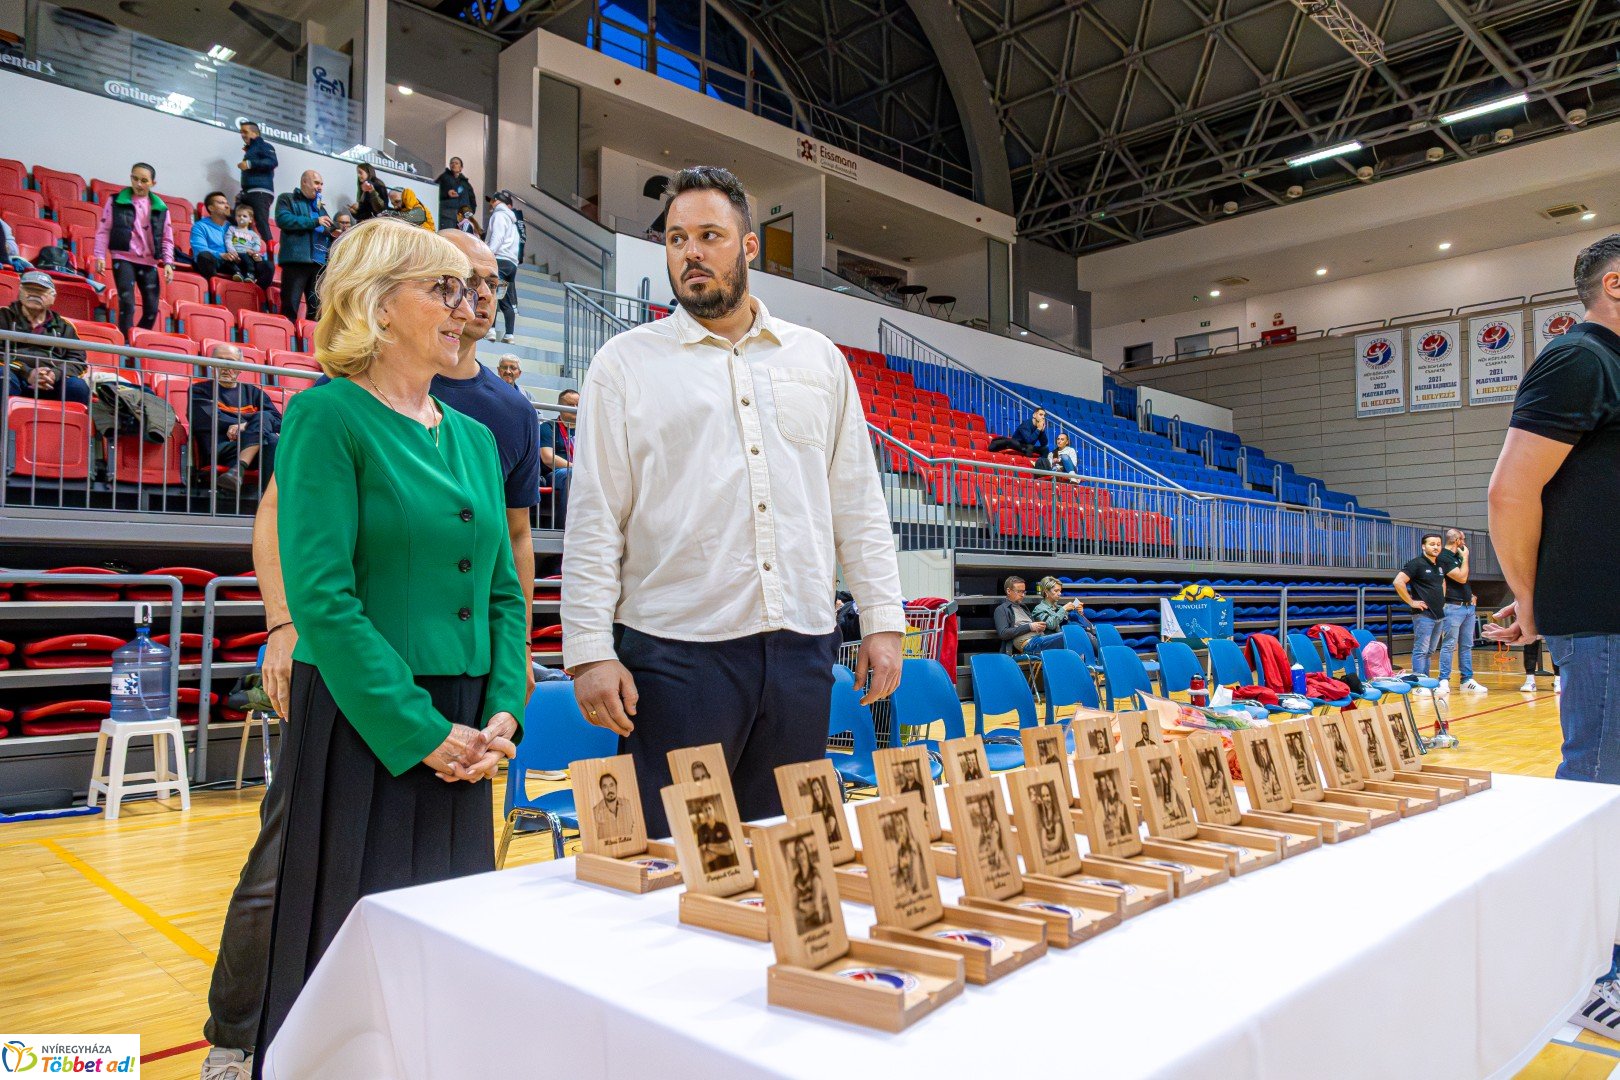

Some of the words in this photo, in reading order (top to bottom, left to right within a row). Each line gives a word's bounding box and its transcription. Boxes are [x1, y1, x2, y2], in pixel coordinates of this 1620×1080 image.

[0, 53, 42, 72] ental
[235, 117, 303, 144] Ctinental
[820, 145, 857, 170] Eissmann
[1373, 382, 1387, 390] 2023
[1476, 376, 1500, 385] MAGYAR
